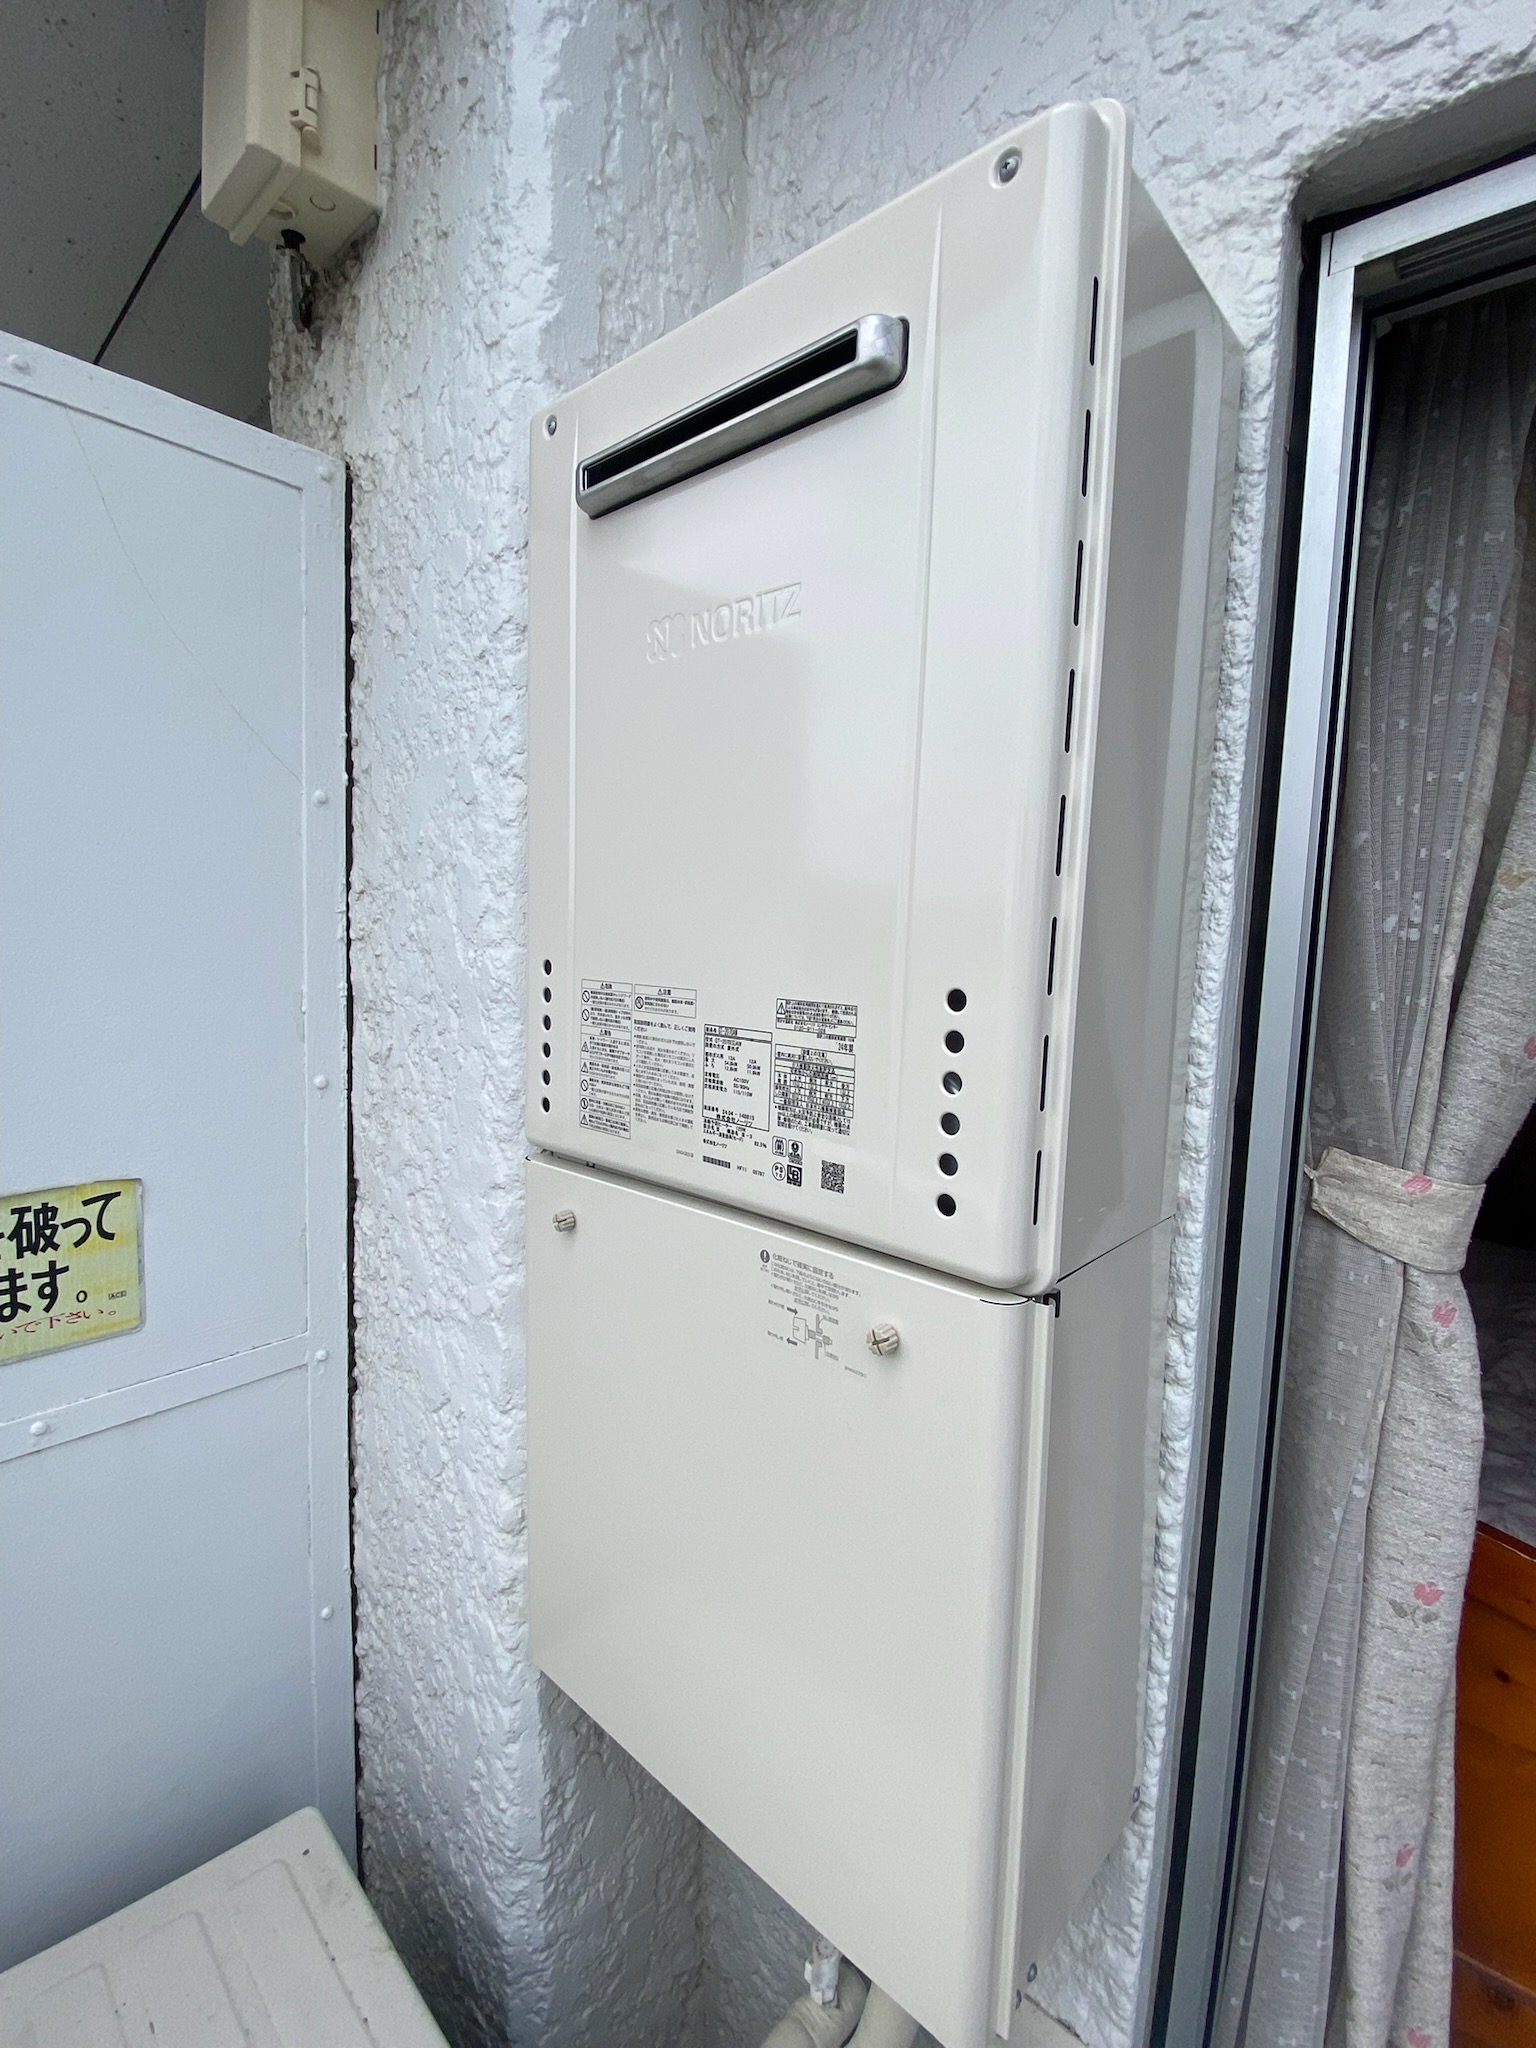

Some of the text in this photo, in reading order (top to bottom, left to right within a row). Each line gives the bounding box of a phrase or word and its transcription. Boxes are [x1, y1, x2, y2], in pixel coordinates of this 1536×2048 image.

[691, 582, 802, 648] NORITZ
[0, 1191, 122, 1260] 破って
